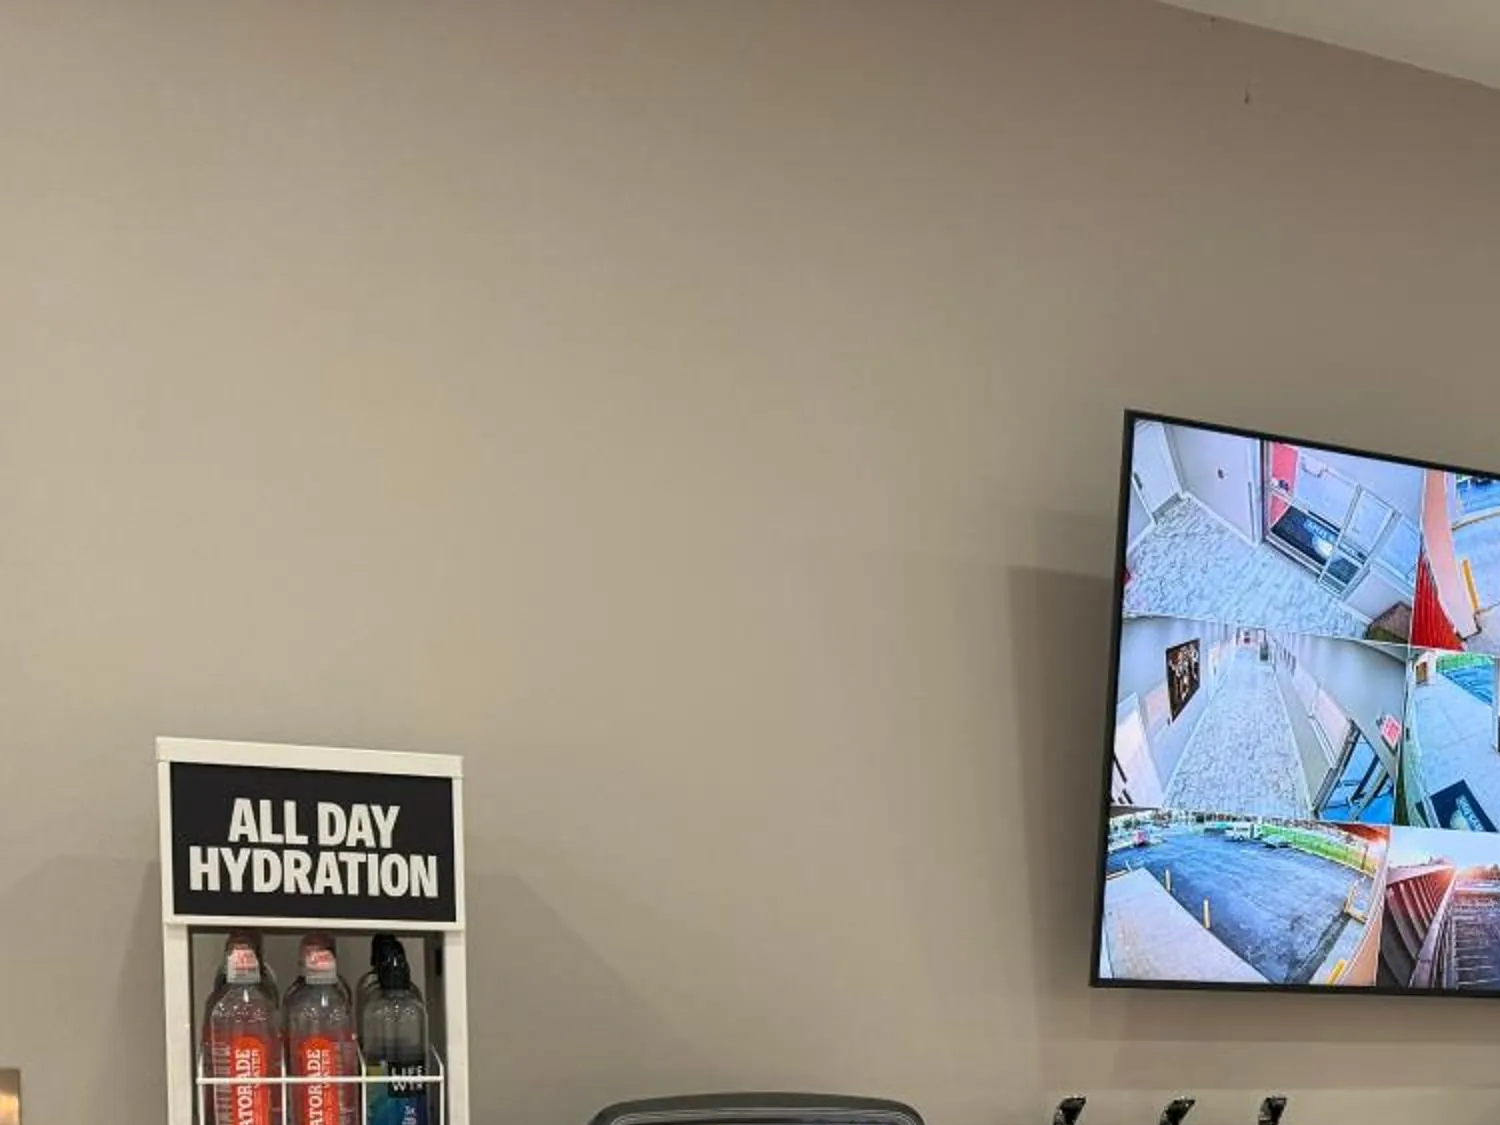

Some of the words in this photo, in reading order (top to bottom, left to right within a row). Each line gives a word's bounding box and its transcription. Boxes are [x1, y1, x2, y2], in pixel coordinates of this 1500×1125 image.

[228, 798, 308, 845] ALL
[317, 802, 400, 849] DAY
[189, 846, 439, 898] HYDRATION
